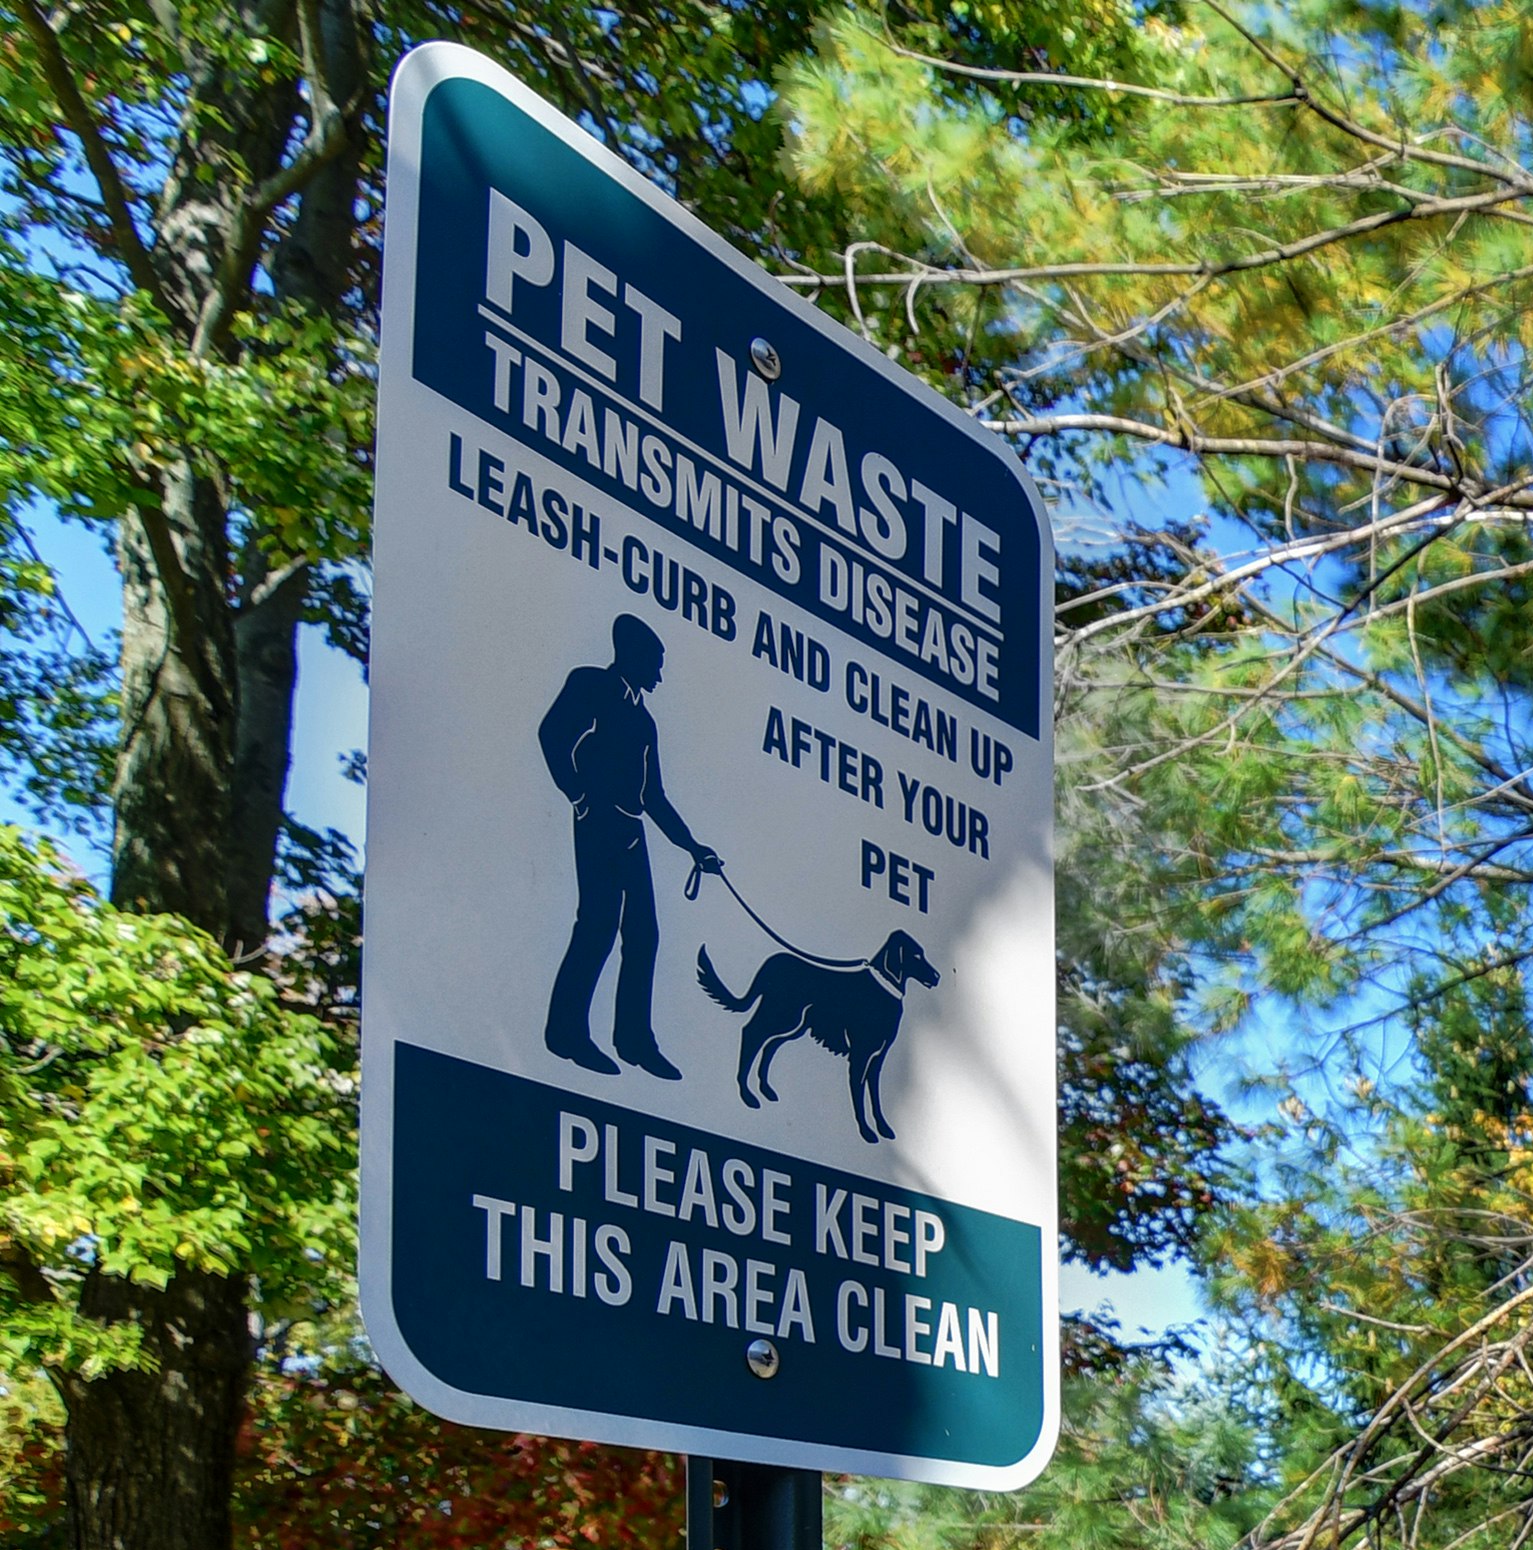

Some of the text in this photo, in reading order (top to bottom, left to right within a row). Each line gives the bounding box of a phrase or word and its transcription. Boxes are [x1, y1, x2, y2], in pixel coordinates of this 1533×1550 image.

[486, 187, 1001, 607] PET WASTE
[448, 431, 1014, 787] LEASH-CURB AND CLEAN UP
[484, 331, 1000, 703] TRANSMITS DISEASE
[762, 706, 991, 861] AFTER YOUR
[861, 839, 936, 915] PET
[472, 1194, 1000, 1379] THIS AREA CLEAN
[558, 1110, 946, 1279] PLEASE KEEP
